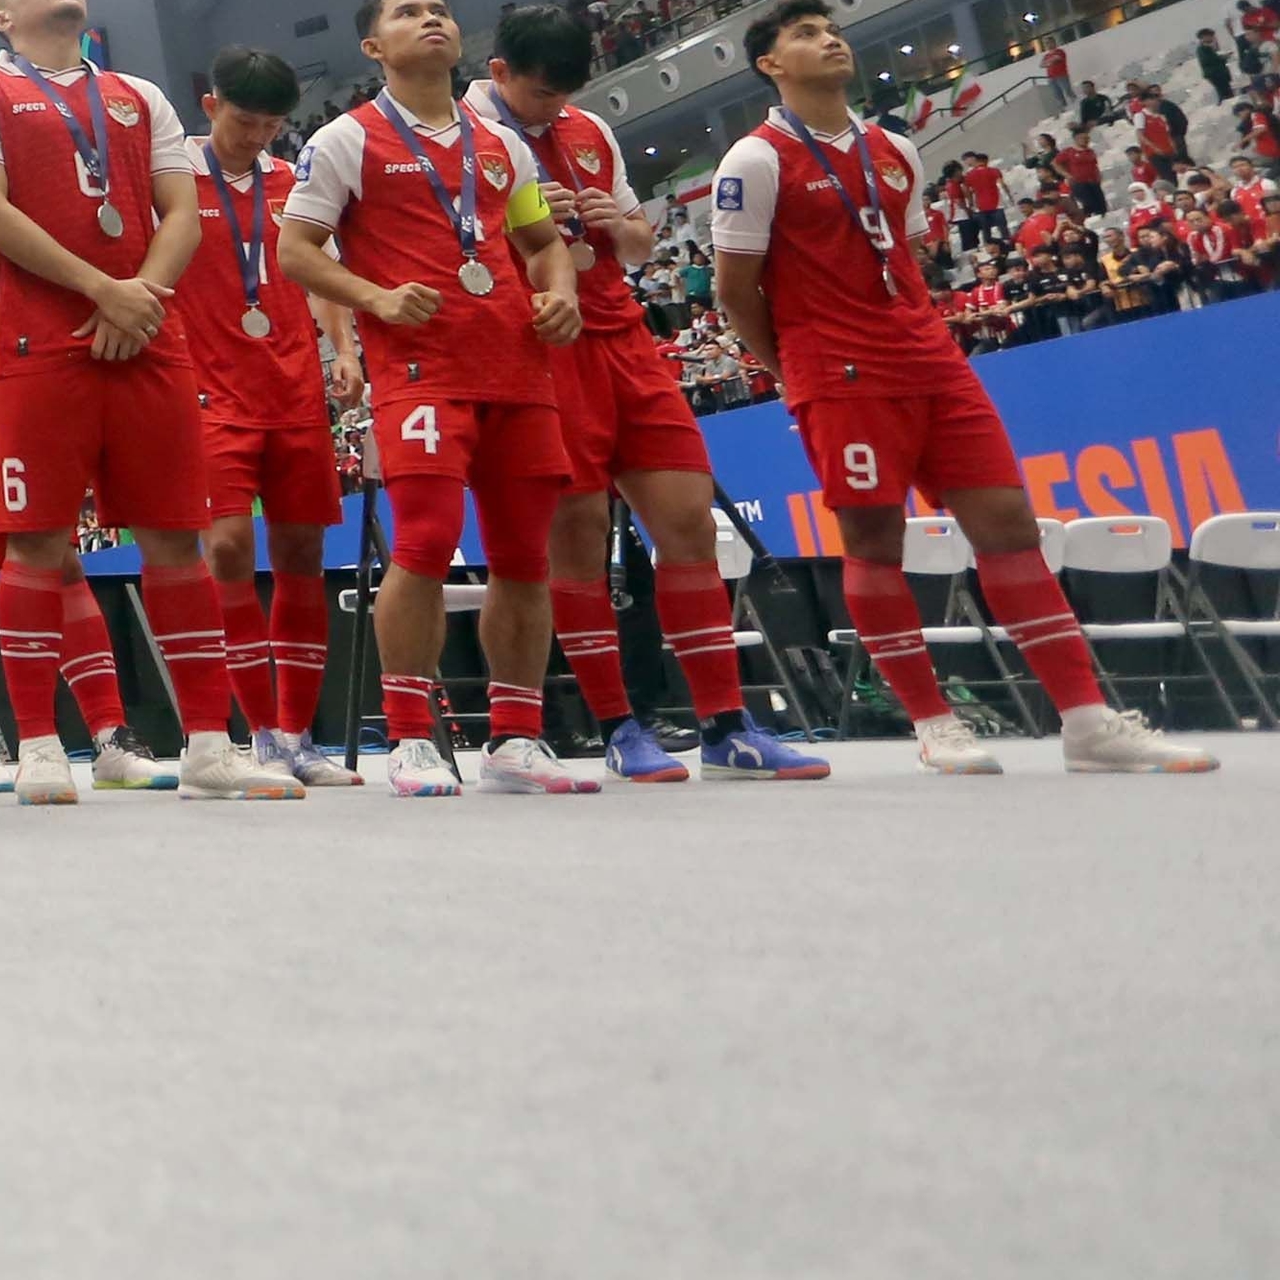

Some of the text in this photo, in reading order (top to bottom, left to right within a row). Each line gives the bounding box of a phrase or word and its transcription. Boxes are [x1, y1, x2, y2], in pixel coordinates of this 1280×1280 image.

[12, 102, 47, 114] SPECS
[384, 162, 421, 174] SPECS
[859, 207, 895, 251] 9
[401, 404, 441, 455] 4
[2, 457, 28, 512] 6
[844, 442, 878, 490] 9
